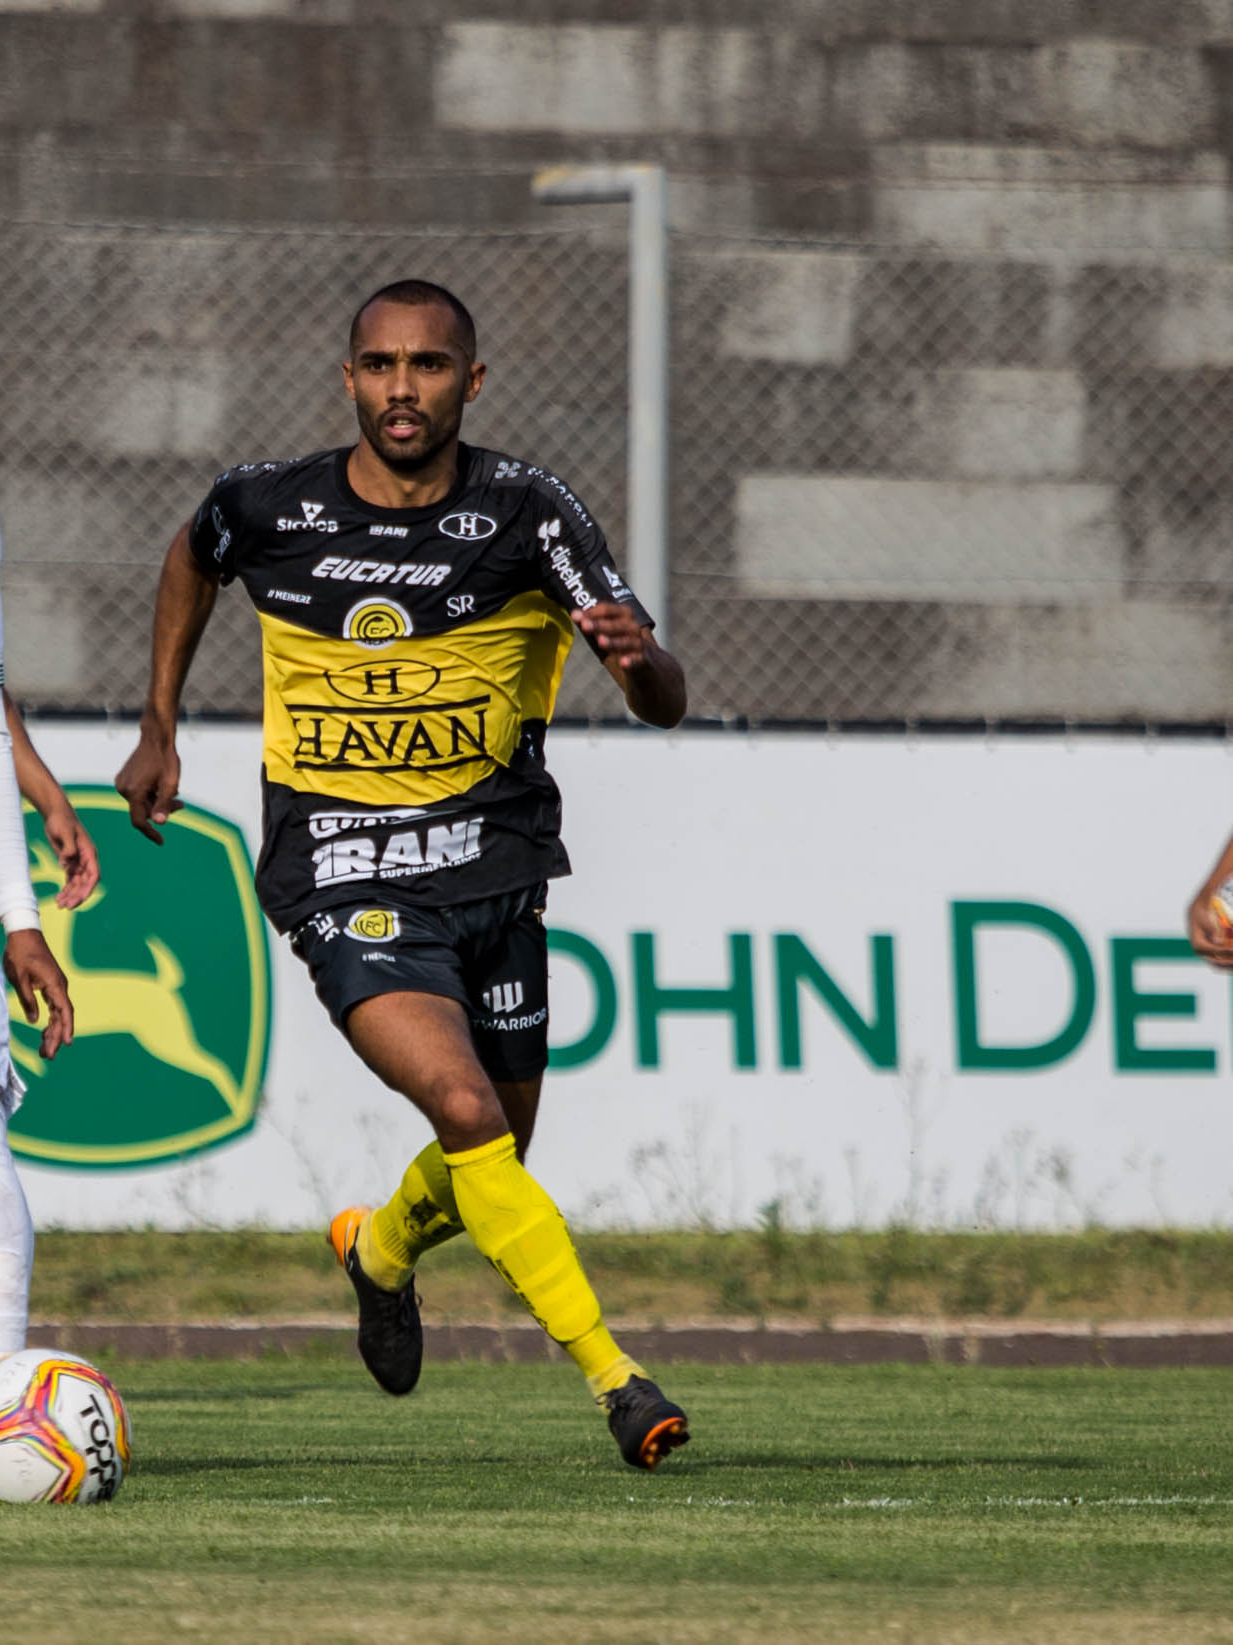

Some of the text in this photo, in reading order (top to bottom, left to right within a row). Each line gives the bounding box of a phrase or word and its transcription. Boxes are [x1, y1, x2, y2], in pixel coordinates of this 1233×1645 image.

[311, 556, 453, 587] EUCATUR
[550, 544, 598, 612] dipelnet
[446, 594, 477, 617] SR
[293, 709, 490, 762] HAVAN
[311, 817, 485, 884] IRANI
[80, 1394, 118, 1500] TOPP
